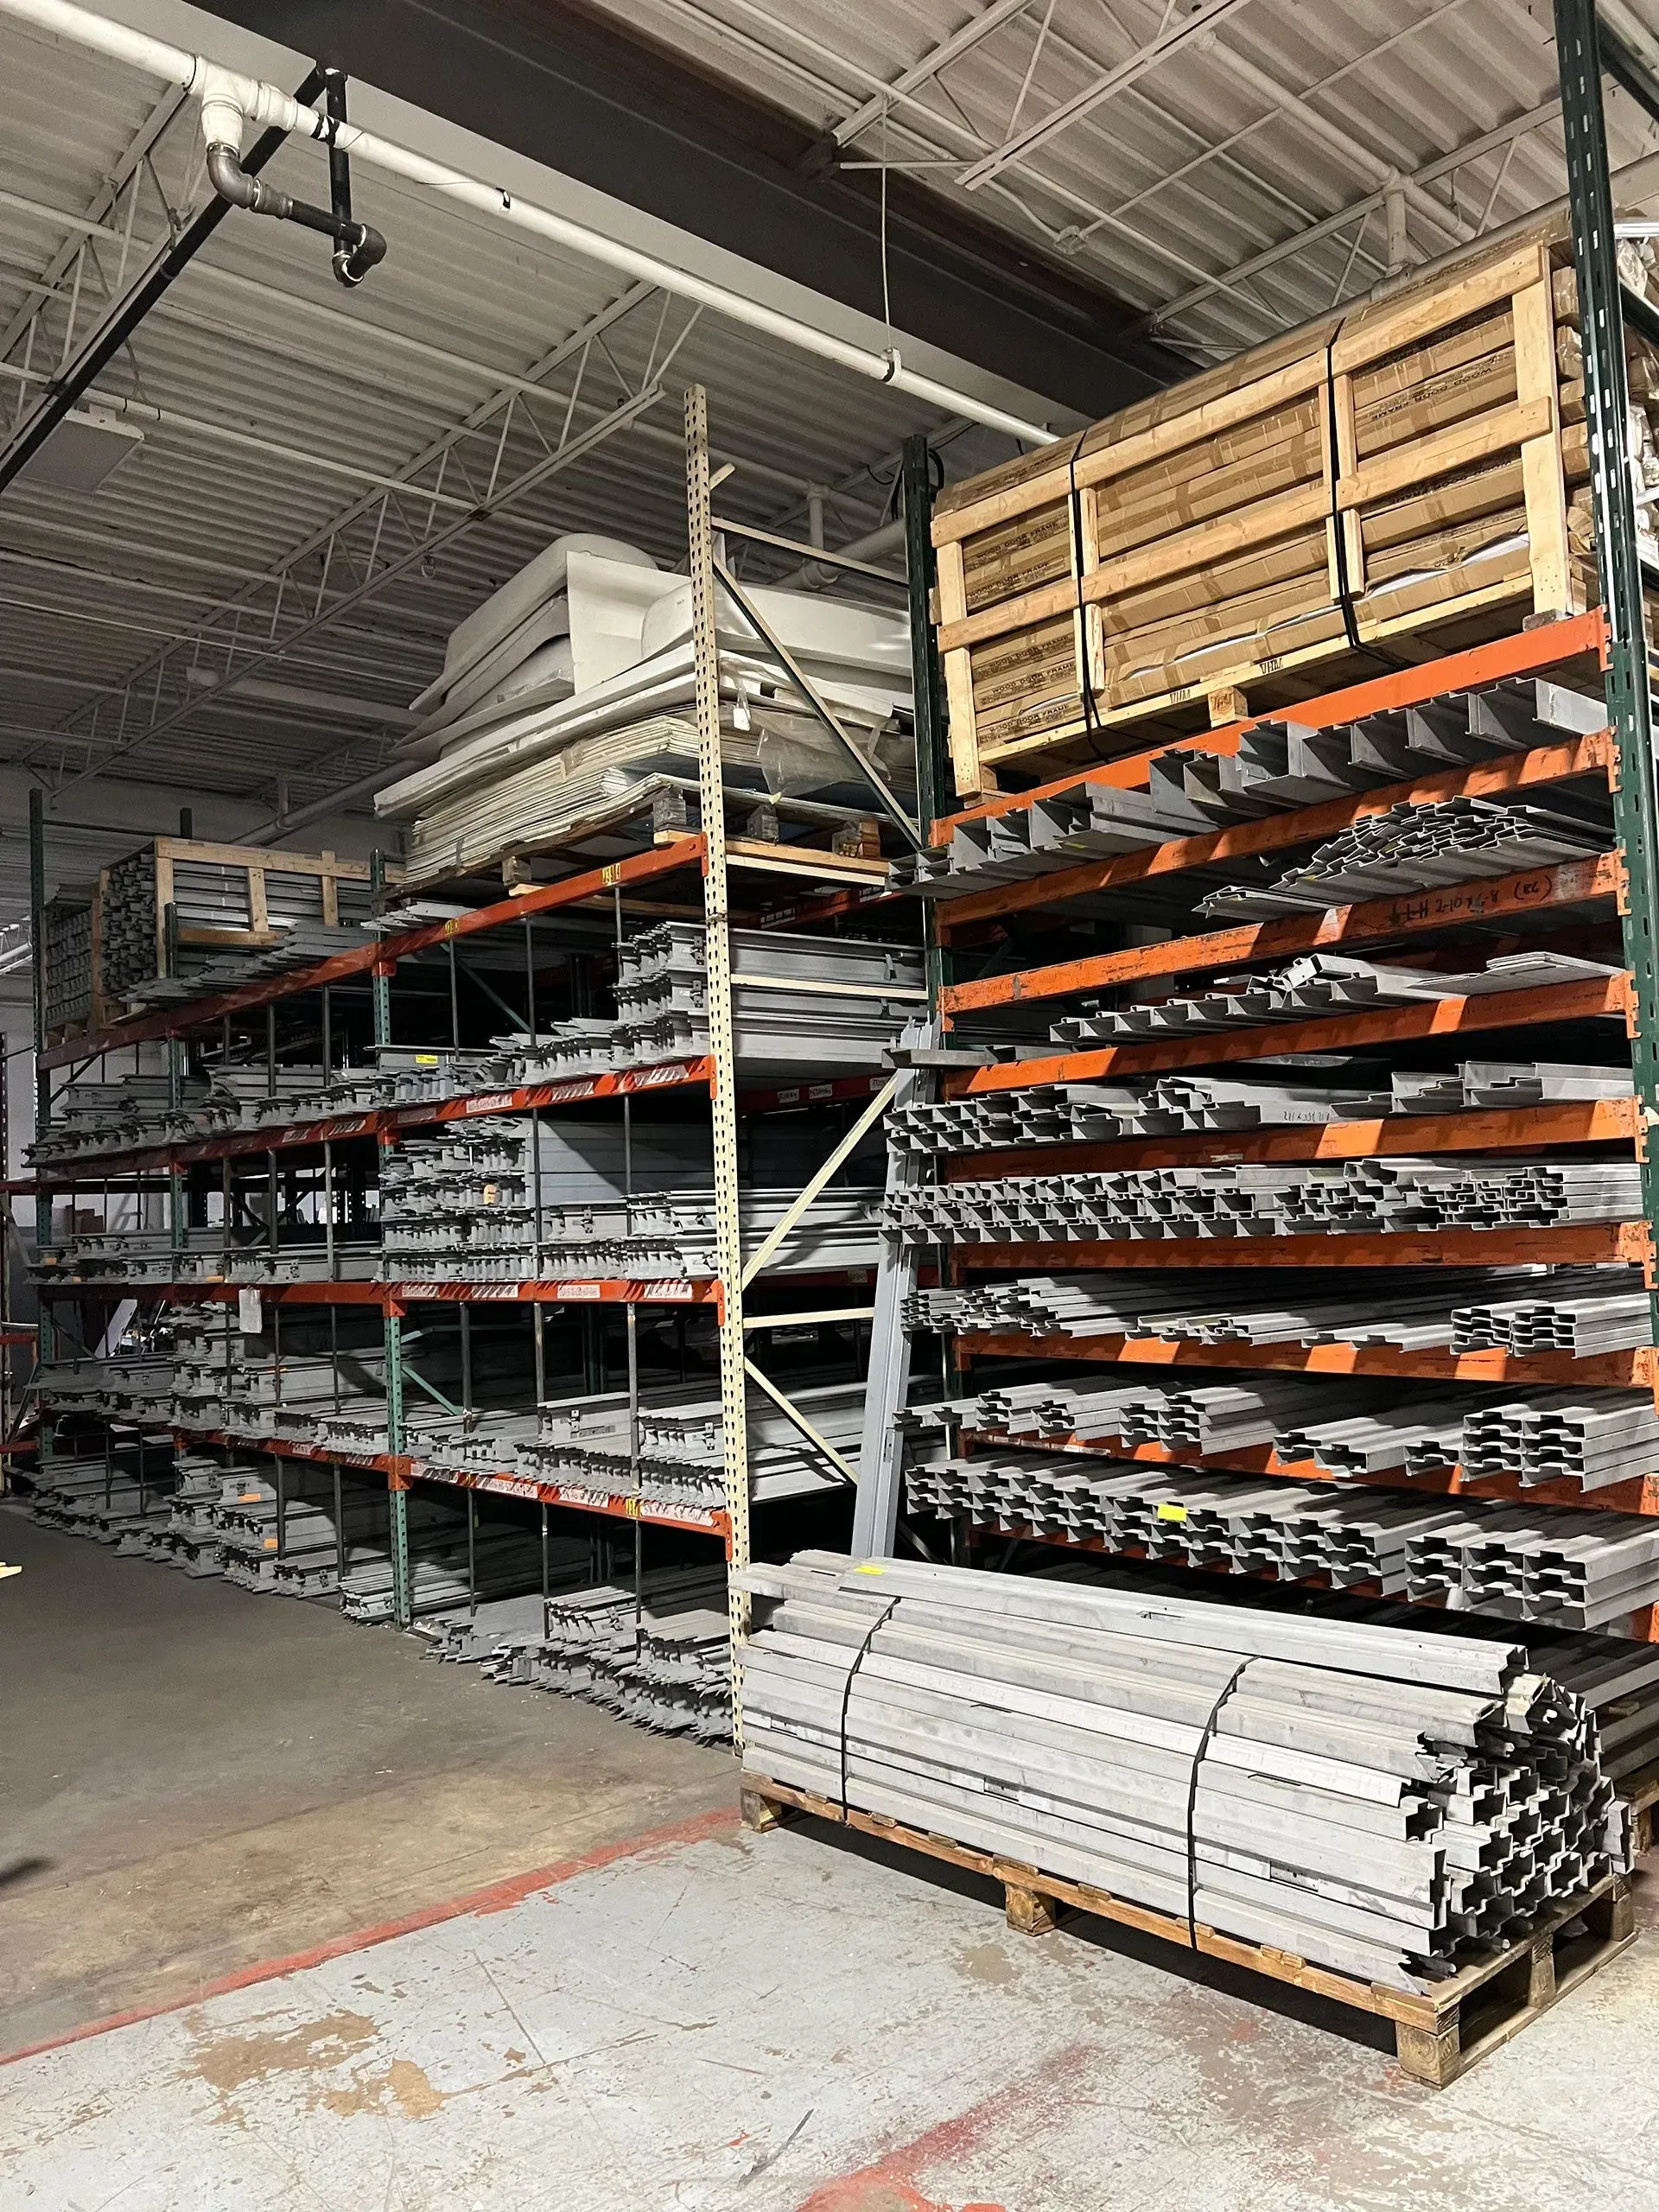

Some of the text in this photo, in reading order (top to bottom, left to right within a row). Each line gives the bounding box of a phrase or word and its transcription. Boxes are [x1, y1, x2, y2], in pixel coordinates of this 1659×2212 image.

[1454, 367, 1492, 385] WOOD
[1414, 385, 1448, 402] DOOR
[976, 521, 1058, 559] WOOD DOOR FRAME
[969, 584, 995, 597] WOOD
[995, 573, 1020, 587] DOOR
[988, 636, 1069, 668] WOOD DOOR FRAME
[992, 662, 1075, 694] WOOD DOOR FRAME
[989, 703, 1070, 734] WOOD DOOR FRAME
